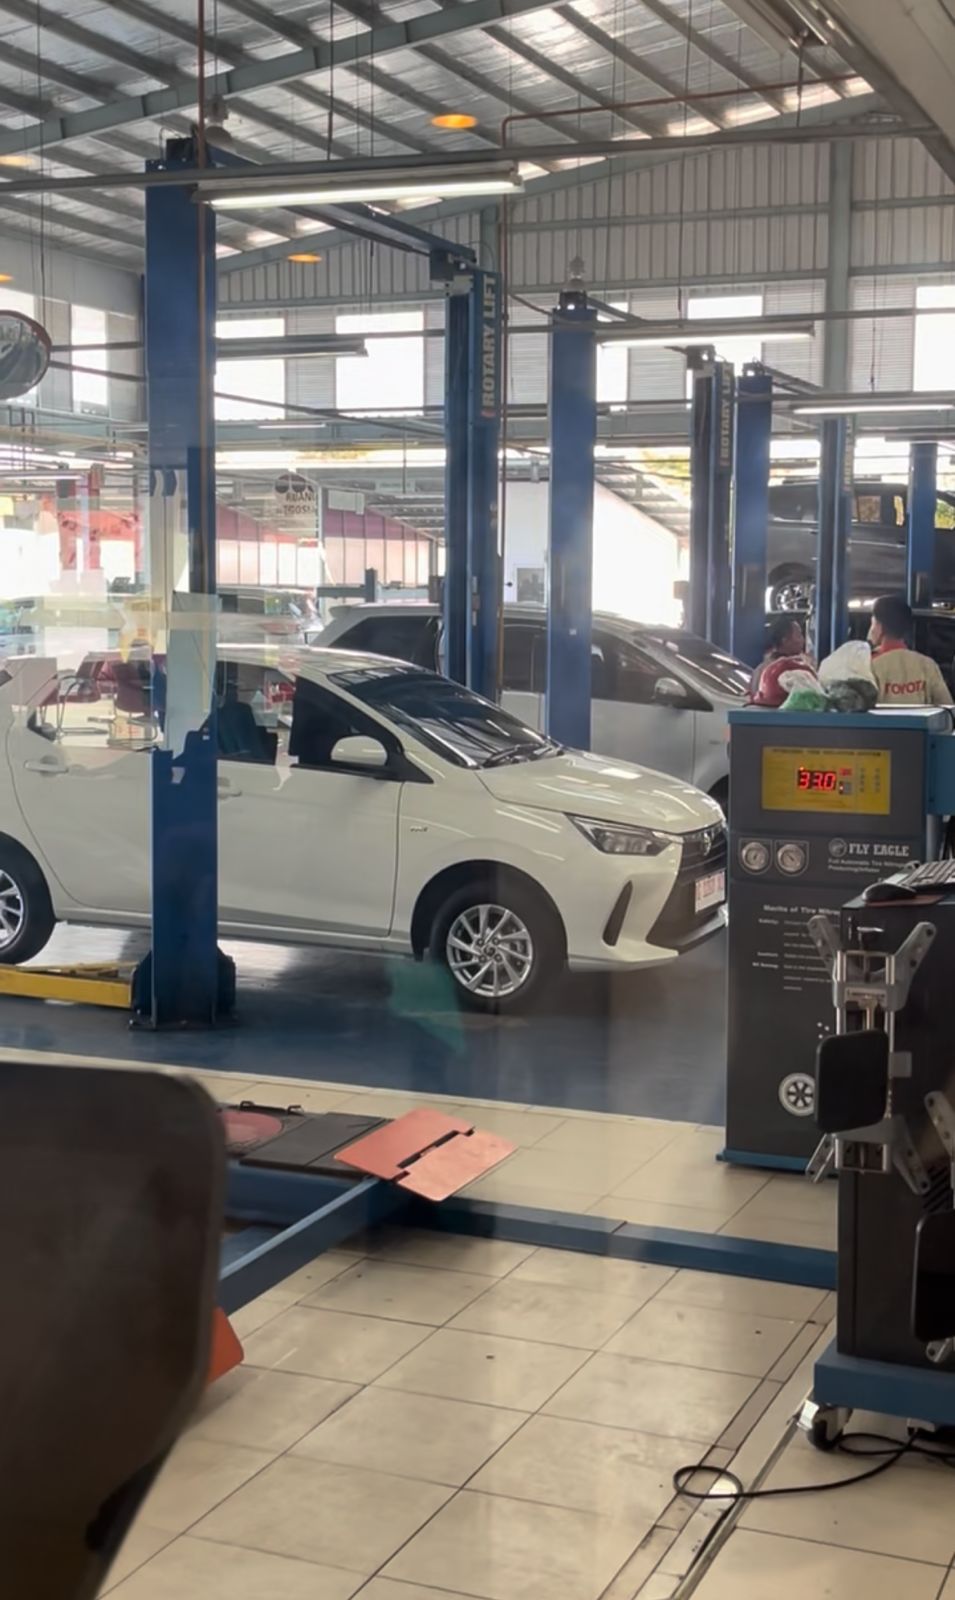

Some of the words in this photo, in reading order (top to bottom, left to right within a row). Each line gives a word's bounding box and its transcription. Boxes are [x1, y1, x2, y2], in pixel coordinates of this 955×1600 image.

[483, 274, 496, 319] LIFT
[482, 324, 496, 407] ROTARY
[849, 843, 870, 855] FLY
[873, 844, 910, 857] EAGLE
